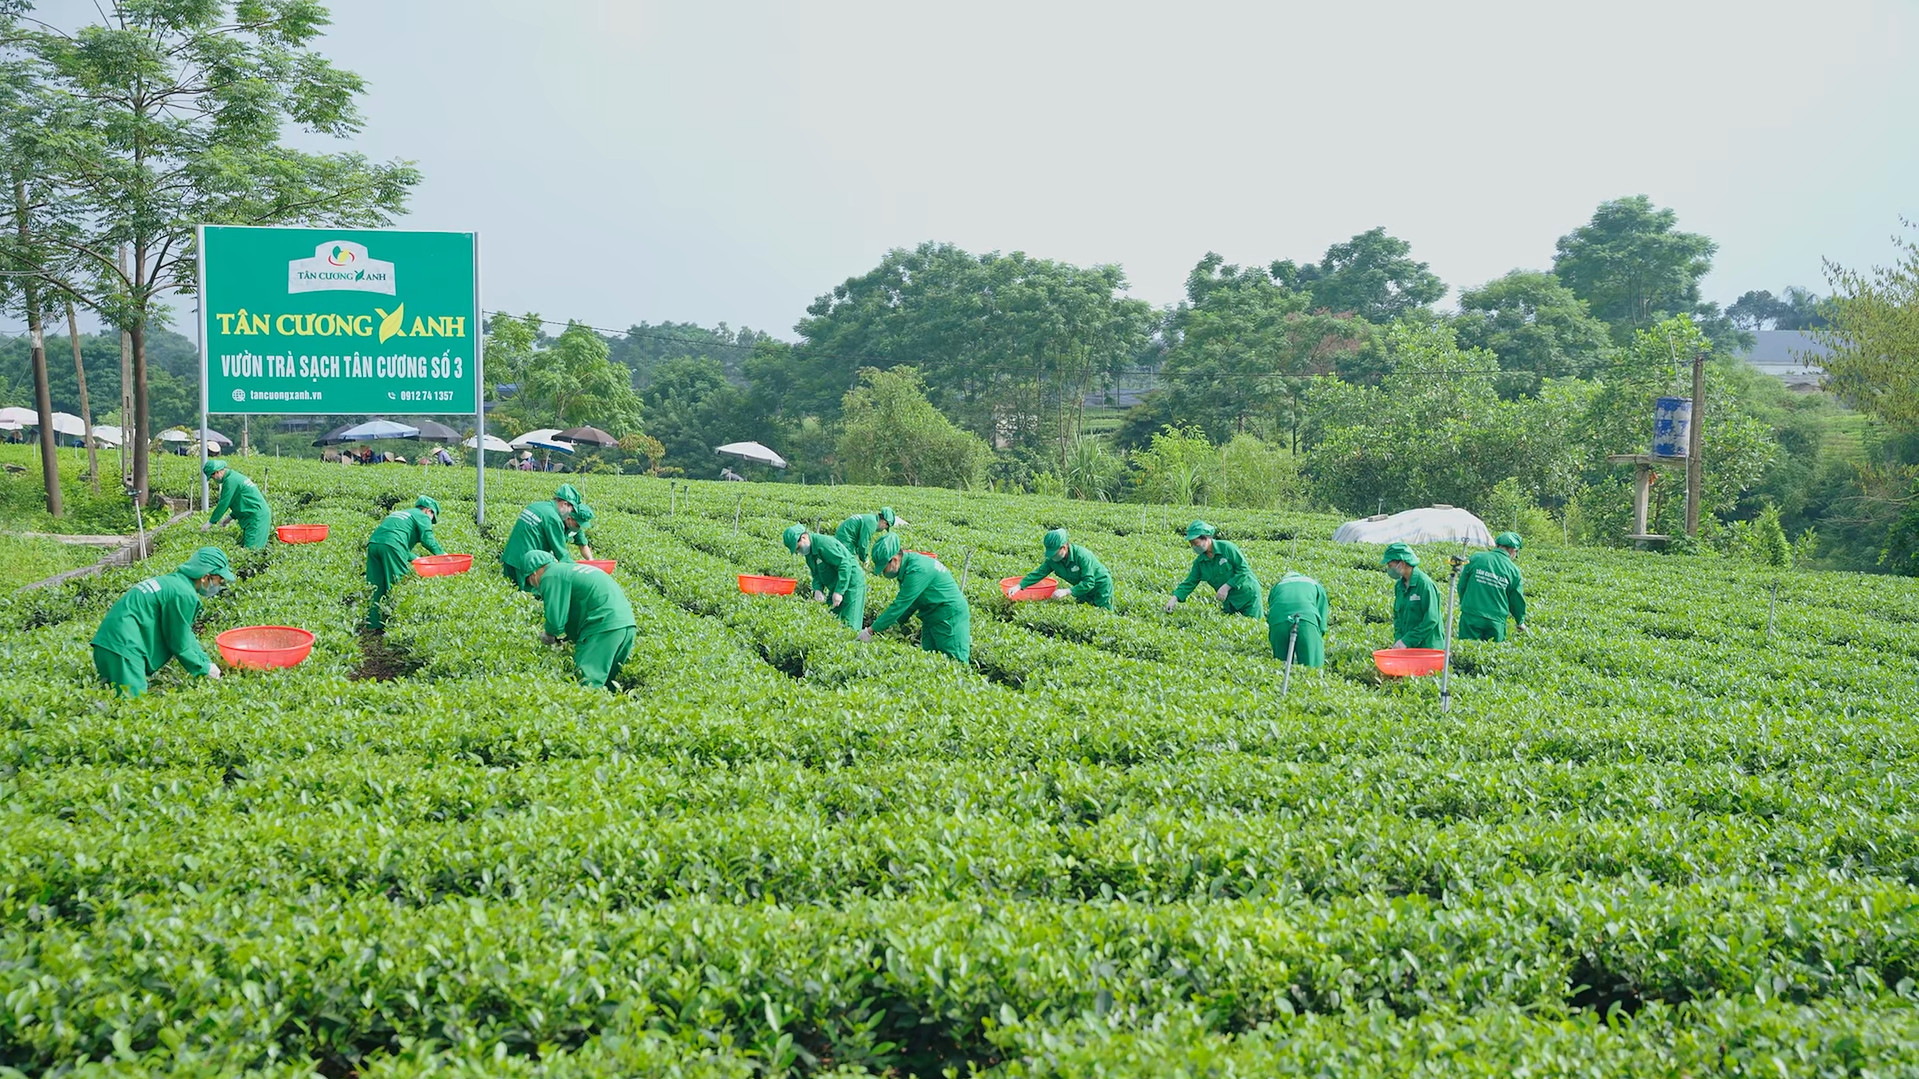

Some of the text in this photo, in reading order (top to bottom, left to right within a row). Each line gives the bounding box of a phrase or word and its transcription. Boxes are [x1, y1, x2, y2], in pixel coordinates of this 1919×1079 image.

[297, 270, 316, 280] TÂN
[318, 271, 353, 280] CƯƠNG
[216, 308, 270, 335] TÂN
[276, 313, 373, 336] CƯƠNG
[221, 349, 463, 382] VƯỜN TRÀ SẠCH TÂN CƯƠNG SỐ 3
[250, 390, 322, 401] tancuongxanh.vn
[400, 391, 453, 401] 0912 74 1357
